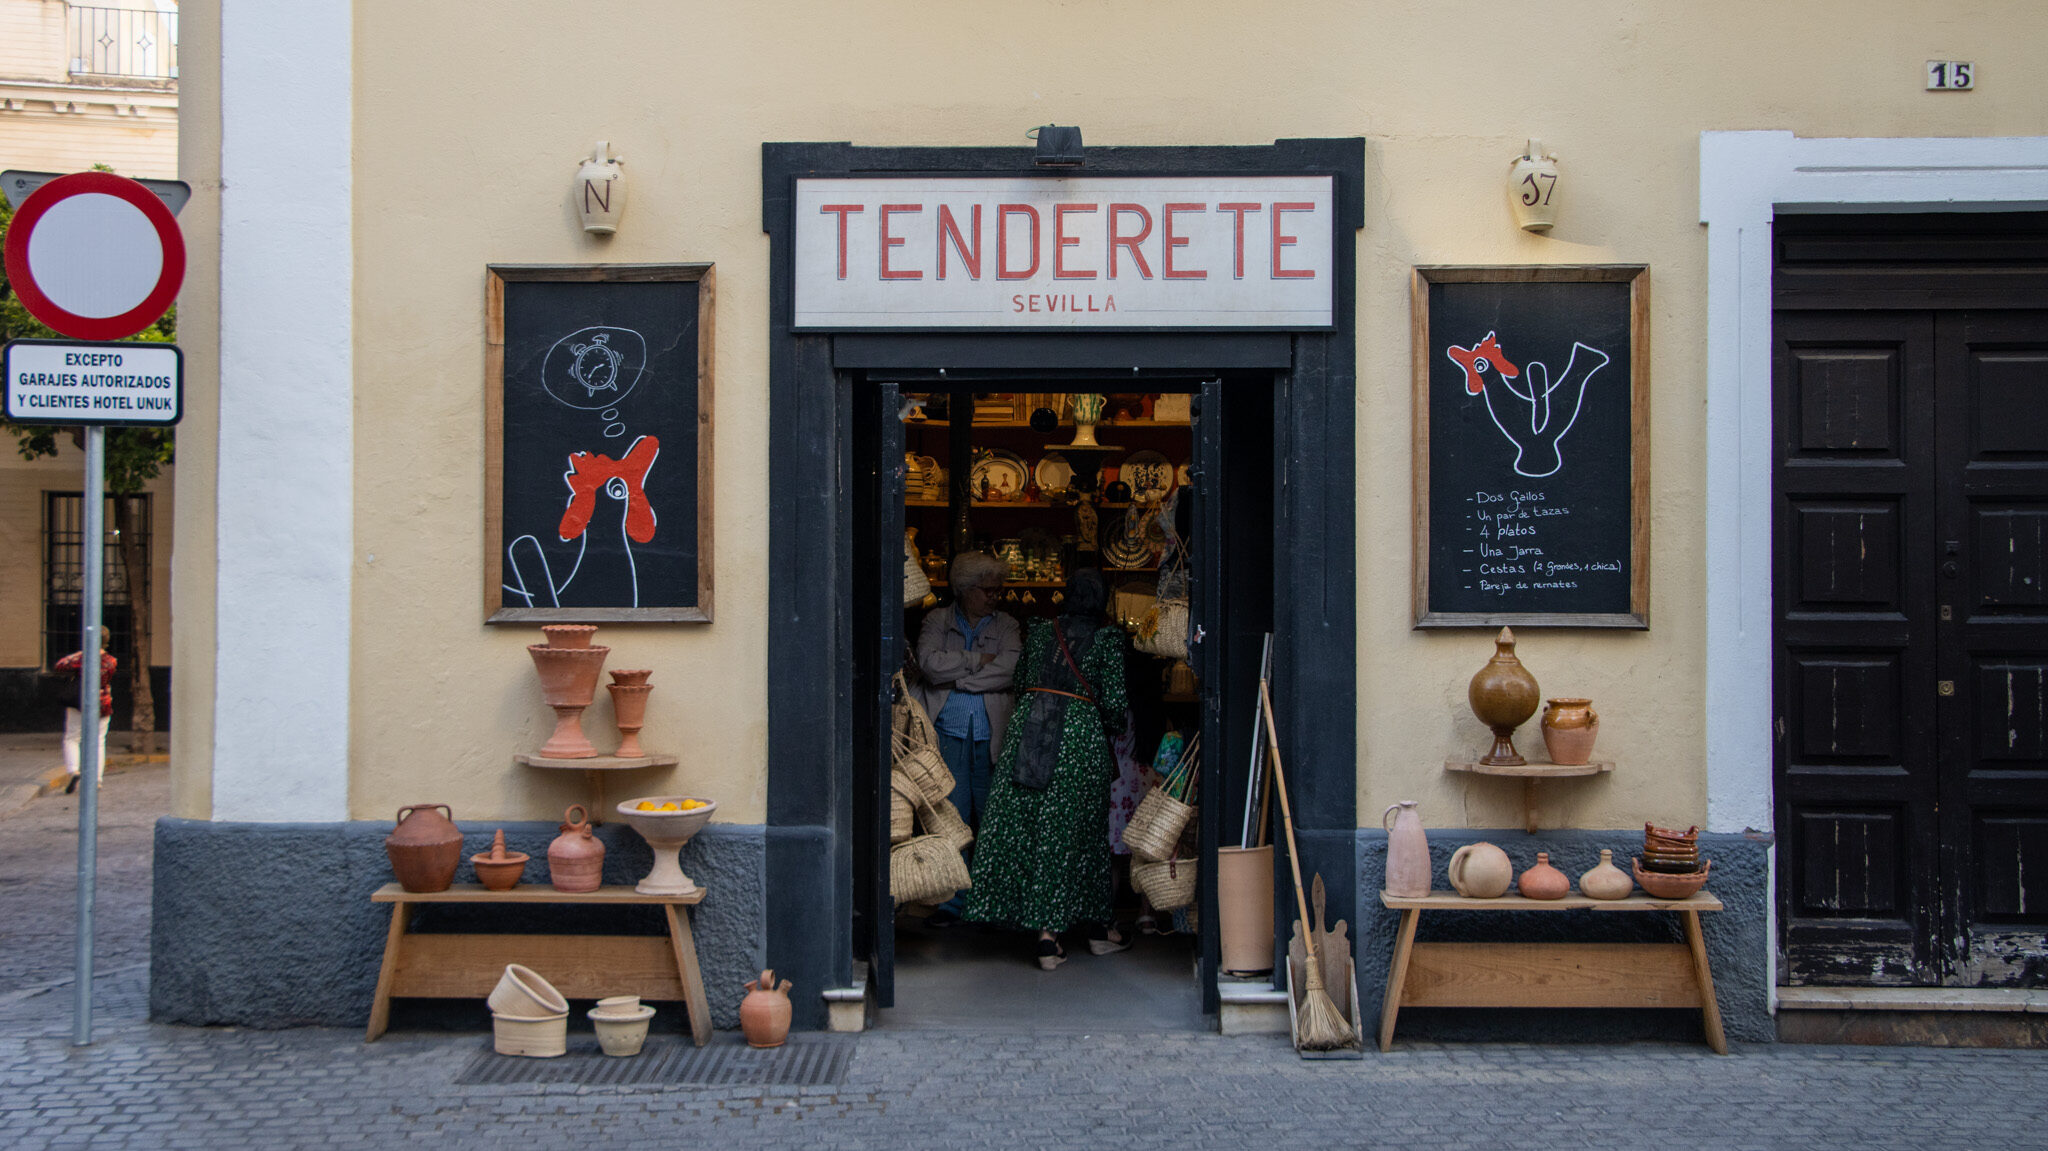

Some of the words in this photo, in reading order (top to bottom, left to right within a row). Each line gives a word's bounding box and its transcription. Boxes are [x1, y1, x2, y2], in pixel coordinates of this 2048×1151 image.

[1930, 63, 1970, 88] 15
[820, 202, 1315, 281] TENDERETE
[1013, 294, 1117, 313] SEVILLA
[65, 353, 123, 367] EXCEPTO
[19, 372, 78, 387] GARAJES
[81, 374, 171, 389] AUTORIZADOS
[18, 394, 26, 407] Y
[29, 394, 90, 408] CLIENTES
[93, 396, 133, 409] HOTEL
[137, 397, 172, 410] UNUK
[1476, 491, 1504, 504] Dos
[1507, 490, 1545, 513] Gallos
[1477, 509, 1492, 521] Un
[1496, 513, 1515, 528] par
[1518, 509, 1530, 519] de
[1533, 505, 1570, 517] tazas
[1479, 524, 1490, 539] 4
[1497, 522, 1536, 540] platos
[1480, 542, 1504, 558] Una
[1506, 545, 1544, 561] Jarra
[1480, 563, 1526, 575] Cestas
[1591, 560, 1622, 573] chica)
[1480, 579, 1511, 595] Pareja
[1515, 580, 1529, 590] de
[1533, 580, 1578, 590] remates
